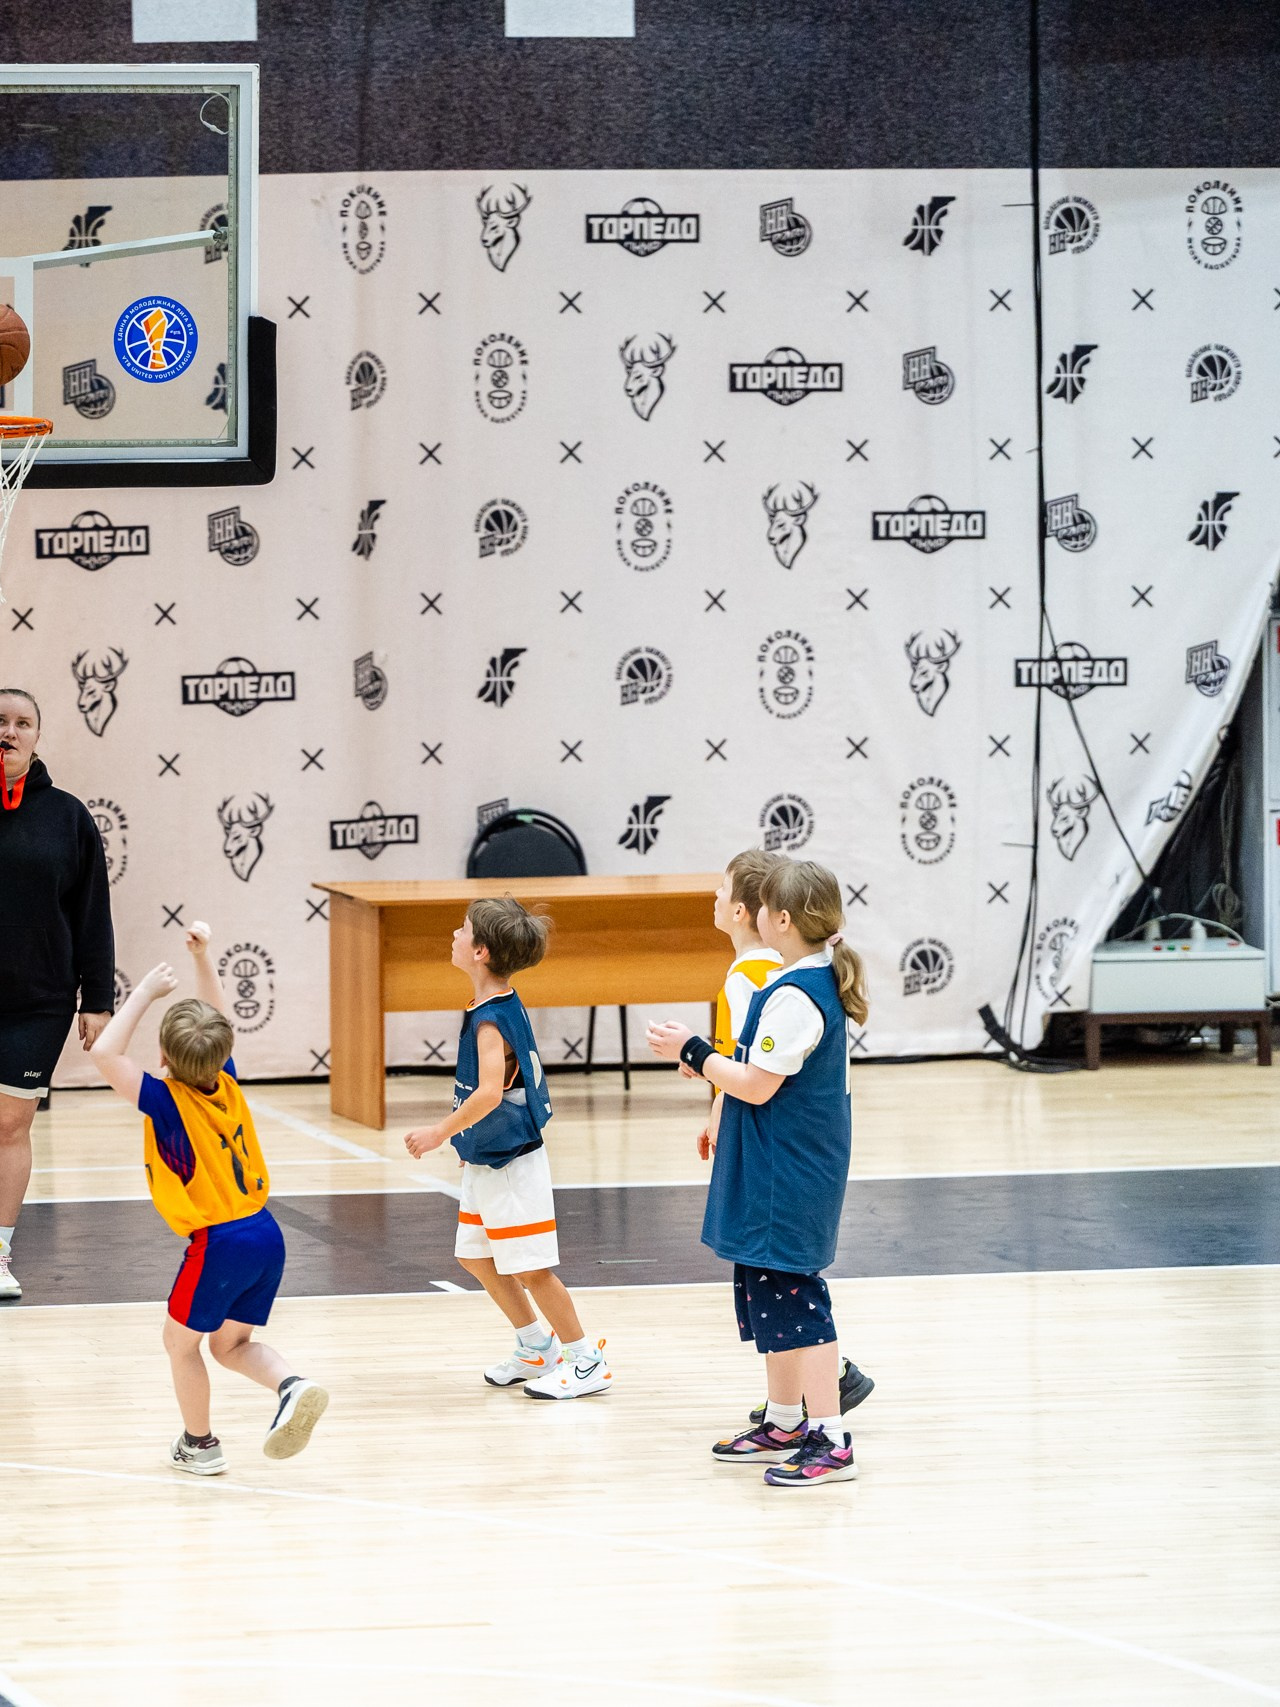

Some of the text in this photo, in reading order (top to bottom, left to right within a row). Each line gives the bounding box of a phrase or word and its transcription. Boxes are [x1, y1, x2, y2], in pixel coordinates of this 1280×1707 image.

[1186, 182, 1243, 214] ПОКОЛЕНИЕ
[588, 216, 696, 240] ТОРПЕДО
[117, 299, 194, 341] ЕДИНАЯ МОЛОДЁЖНАЯ ЛИГА ВТБ
[121, 349, 192, 380] VTB UNITED YOUTH LEAGUE
[731, 365, 840, 390] ТОРПЕДО
[874, 513, 982, 538] ТОРПЕДО
[38, 530, 146, 555] ТОРПЕДО
[184, 676, 292, 700] ТОРПЕДО
[87, 798, 129, 830] ОЛЕНИЕ
[333, 818, 416, 846] ТОРПЕДО
